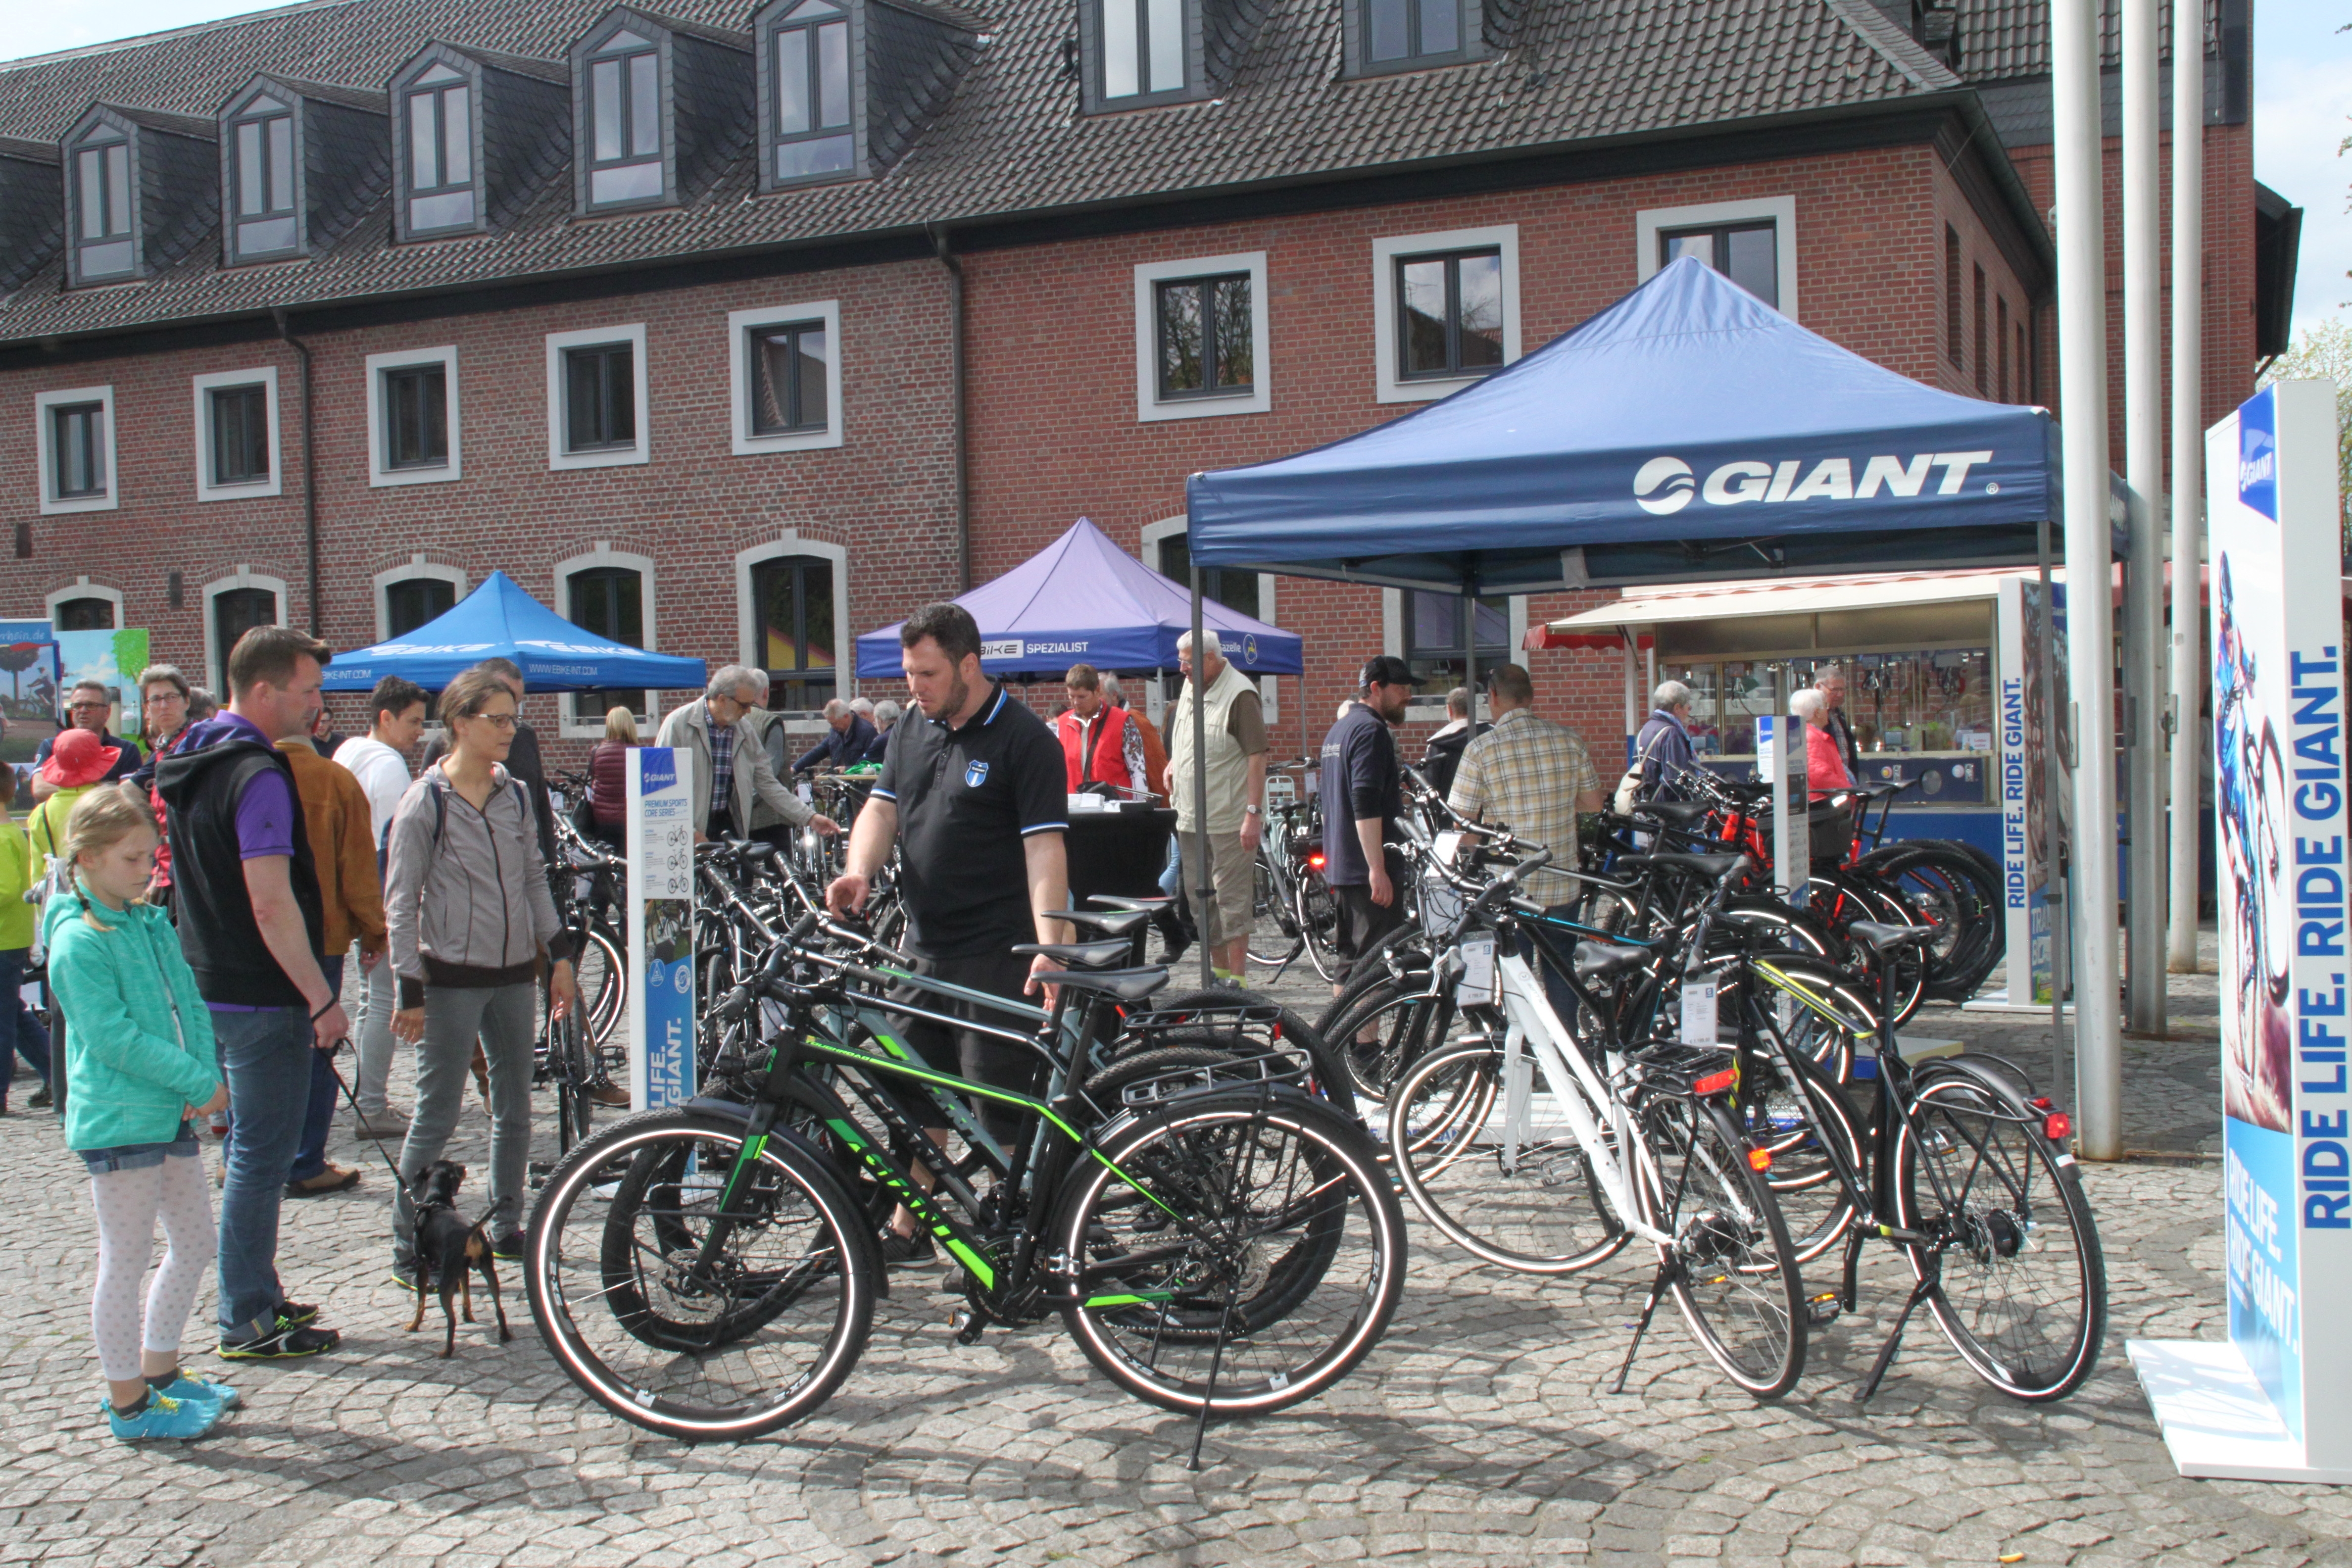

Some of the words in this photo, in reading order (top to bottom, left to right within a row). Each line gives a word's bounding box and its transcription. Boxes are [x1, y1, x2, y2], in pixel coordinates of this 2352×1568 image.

[1703, 450, 1993, 505] GIANT
[2247, 451, 2274, 486] GIANT
[1026, 641, 1088, 654] SPEZIALIST
[1220, 642, 1241, 653] azelle
[2003, 678, 2023, 747] GIANT.
[2290, 645, 2342, 821] GIANT.
[650, 773, 676, 782] GIANT
[669, 798, 687, 807] SPORTS
[2005, 752, 2023, 801] RIDE
[659, 808, 676, 816] SERIES
[2006, 806, 2024, 855] LIFE.
[2007, 860, 2025, 908] RIDE
[2295, 835, 2345, 956] RIDE
[805, 1040, 870, 1061] TOUGHROAD
[2298, 973, 2347, 1093] LIFE.
[650, 1045, 666, 1108] LIFE.
[667, 1017, 682, 1107] GIANT.
[2300, 1109, 2351, 1228] RIDE
[2229, 1147, 2250, 1225] RIDE
[2250, 1177, 2283, 1263] LIFE.
[2230, 1213, 2252, 1294] RIDE
[2252, 1249, 2299, 1355] GIANT.
